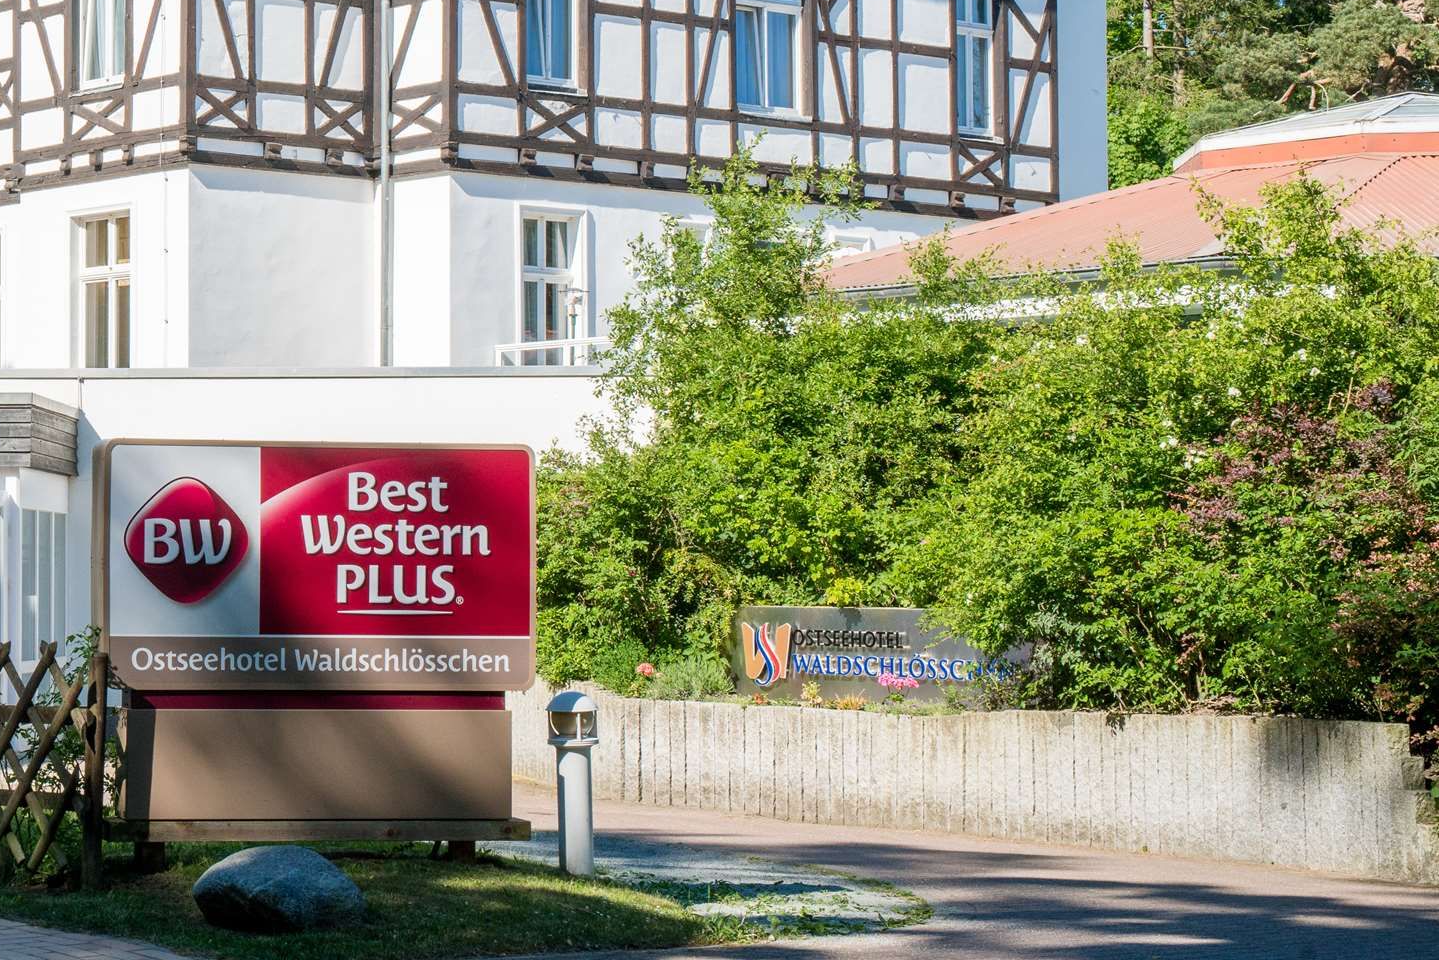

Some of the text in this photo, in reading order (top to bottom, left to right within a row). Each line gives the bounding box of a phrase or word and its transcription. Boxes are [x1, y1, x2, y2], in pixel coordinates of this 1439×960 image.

[347, 471, 449, 513] Best
[143, 518, 232, 565] BW
[300, 514, 491, 556] Western
[793, 629, 904, 649] OSTSEEHOTEL
[131, 647, 511, 673] Ostseehotel Waldschlösschen
[792, 653, 1012, 682] WALDSCHLÖSSC
